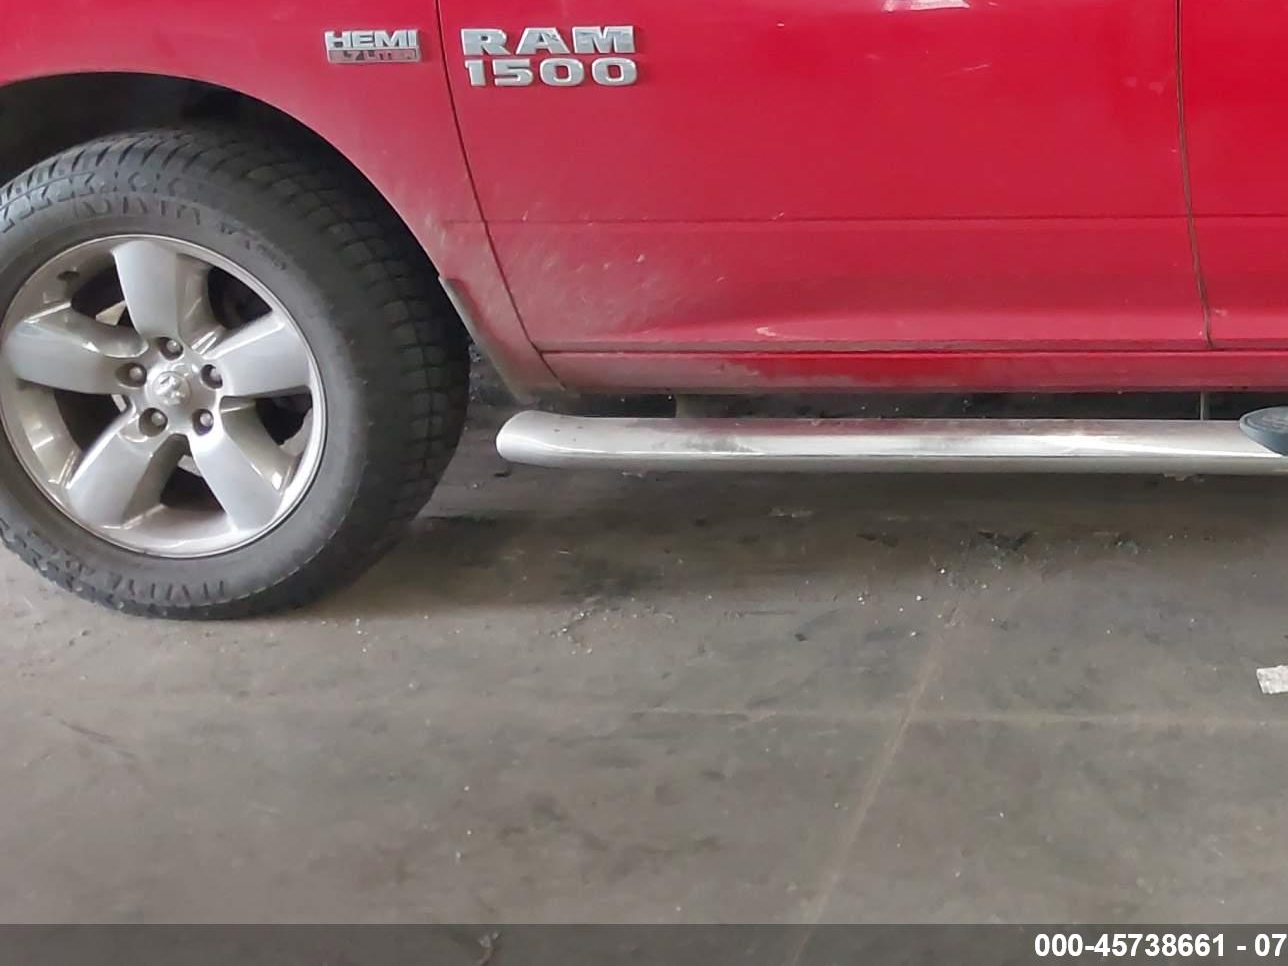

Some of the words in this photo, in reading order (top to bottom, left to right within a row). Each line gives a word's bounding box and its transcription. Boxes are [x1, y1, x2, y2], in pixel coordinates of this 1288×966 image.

[324, 30, 418, 48] HEMI
[460, 26, 637, 56] RAM
[464, 57, 638, 87] 1500
